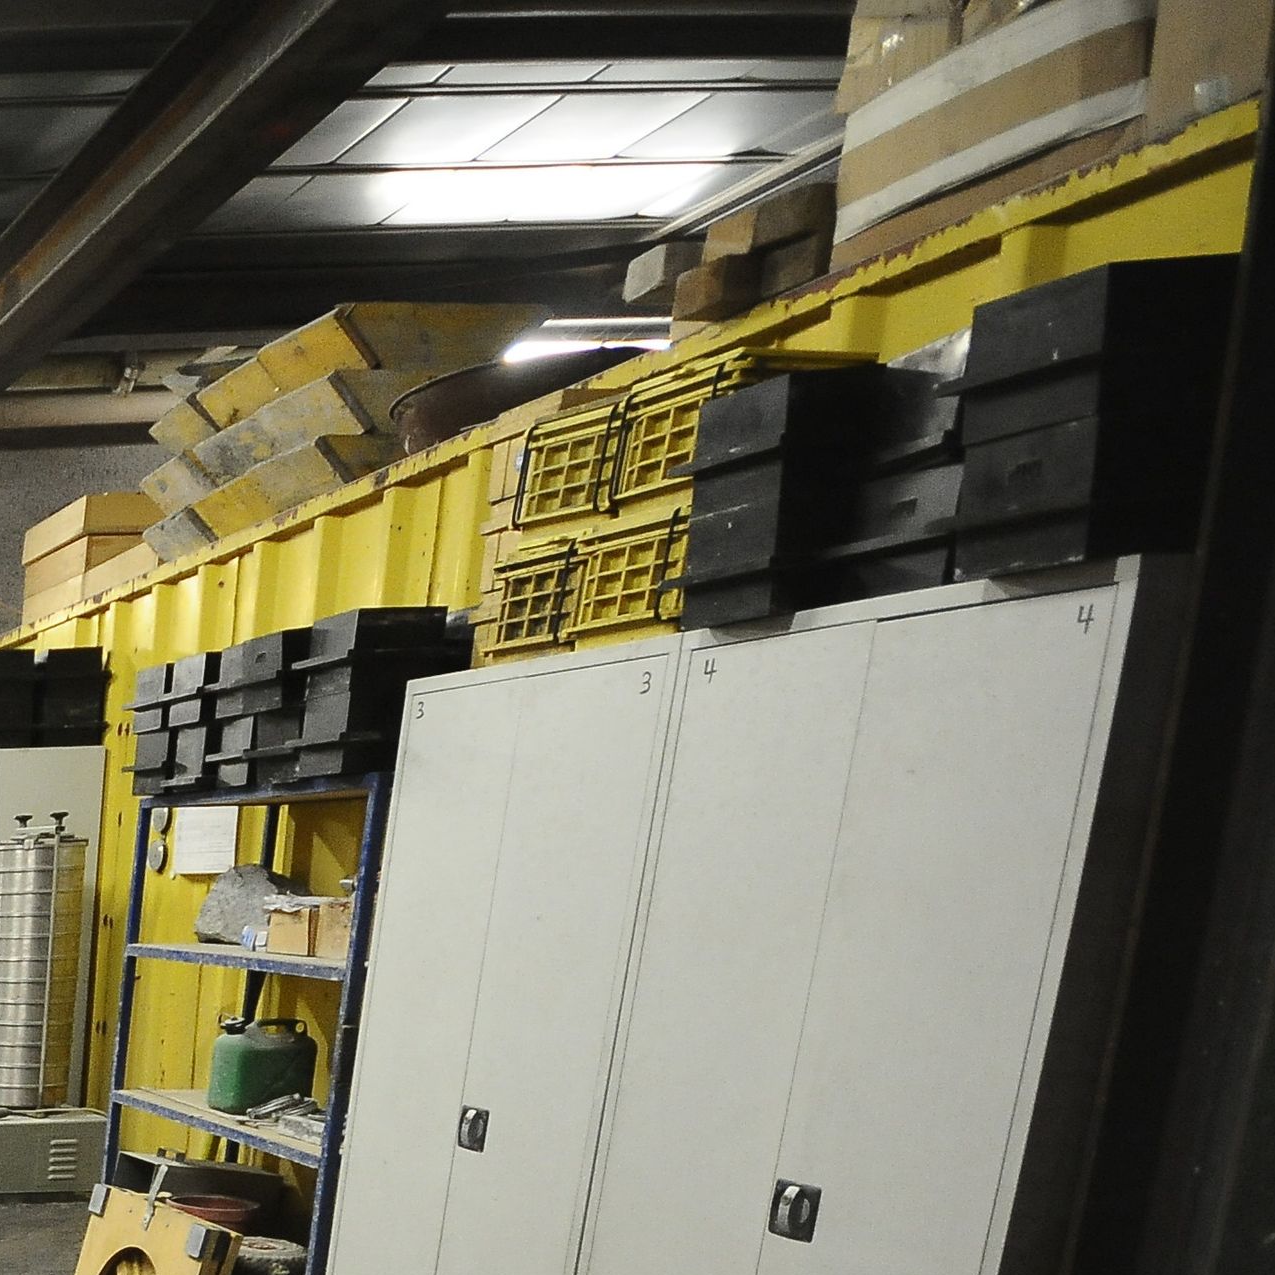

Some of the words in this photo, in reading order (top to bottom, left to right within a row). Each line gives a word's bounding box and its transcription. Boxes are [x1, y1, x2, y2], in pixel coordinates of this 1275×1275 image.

[1076, 603, 1095, 634] 4
[639, 671, 651, 695] 3
[703, 658, 718, 684] 4
[415, 701, 425, 720] 3
